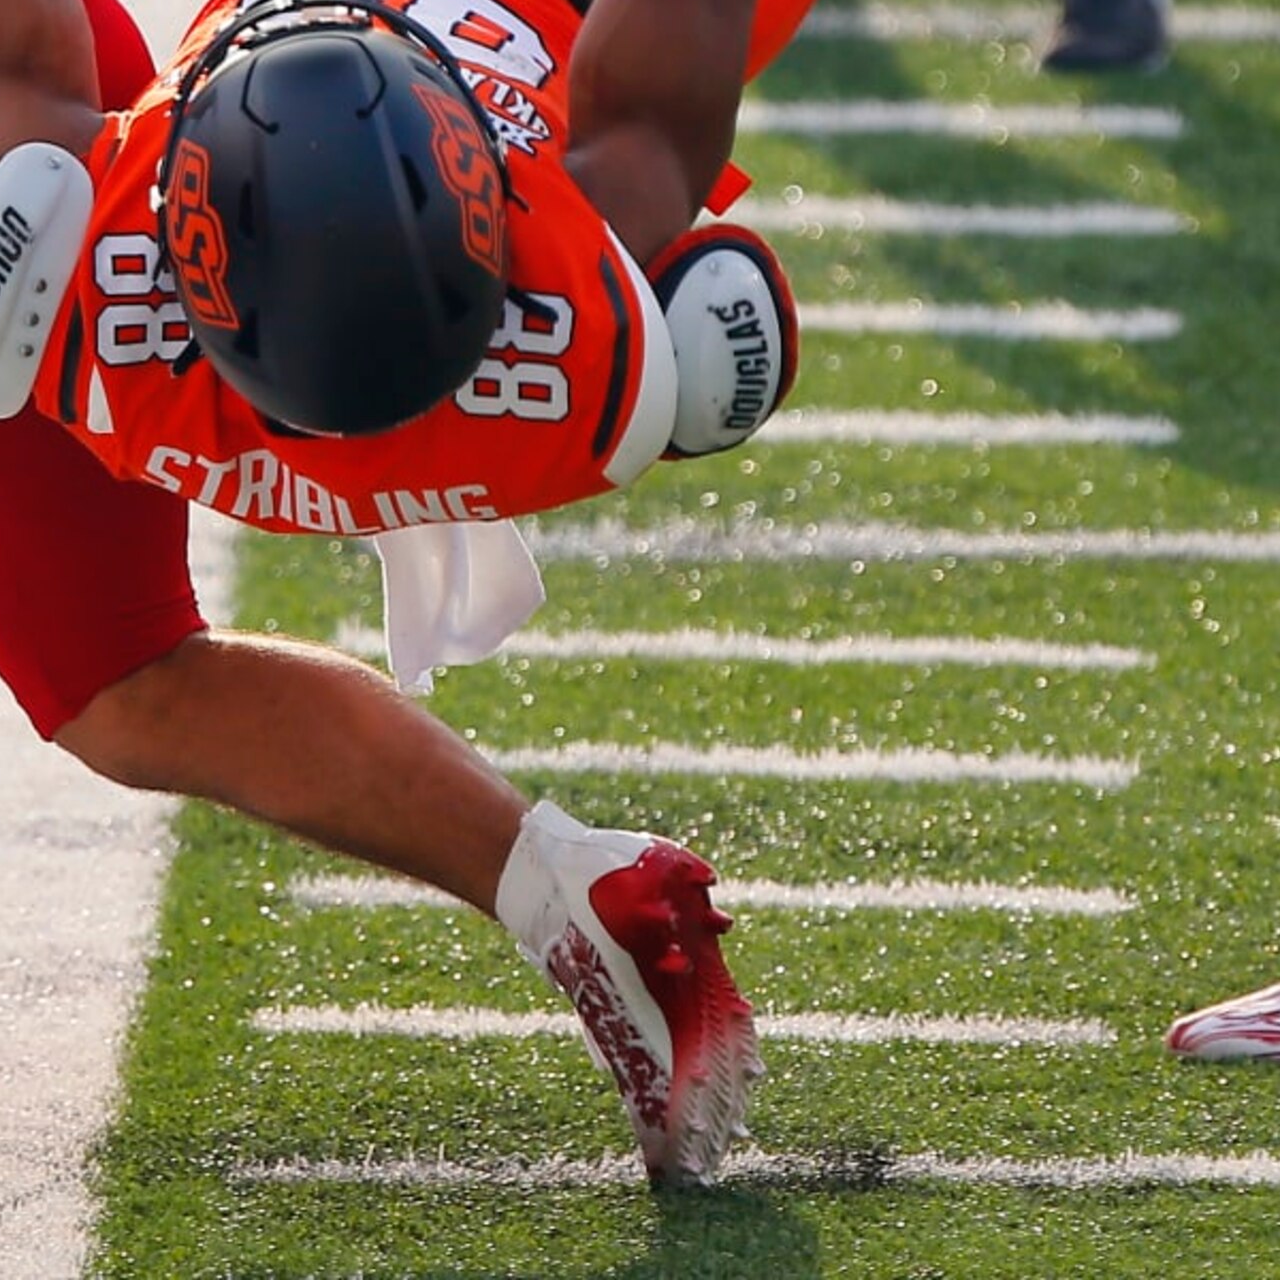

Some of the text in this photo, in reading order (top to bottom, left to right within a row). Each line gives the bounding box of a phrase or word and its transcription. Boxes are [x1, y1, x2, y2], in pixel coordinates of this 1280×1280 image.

[165, 137, 241, 332] OSU
[410, 83, 507, 278] OSU
[94, 231, 196, 366] 88
[454, 290, 576, 422] 88
[706, 298, 771, 429] DOUGLAS
[141, 444, 499, 535] STRIBLING
